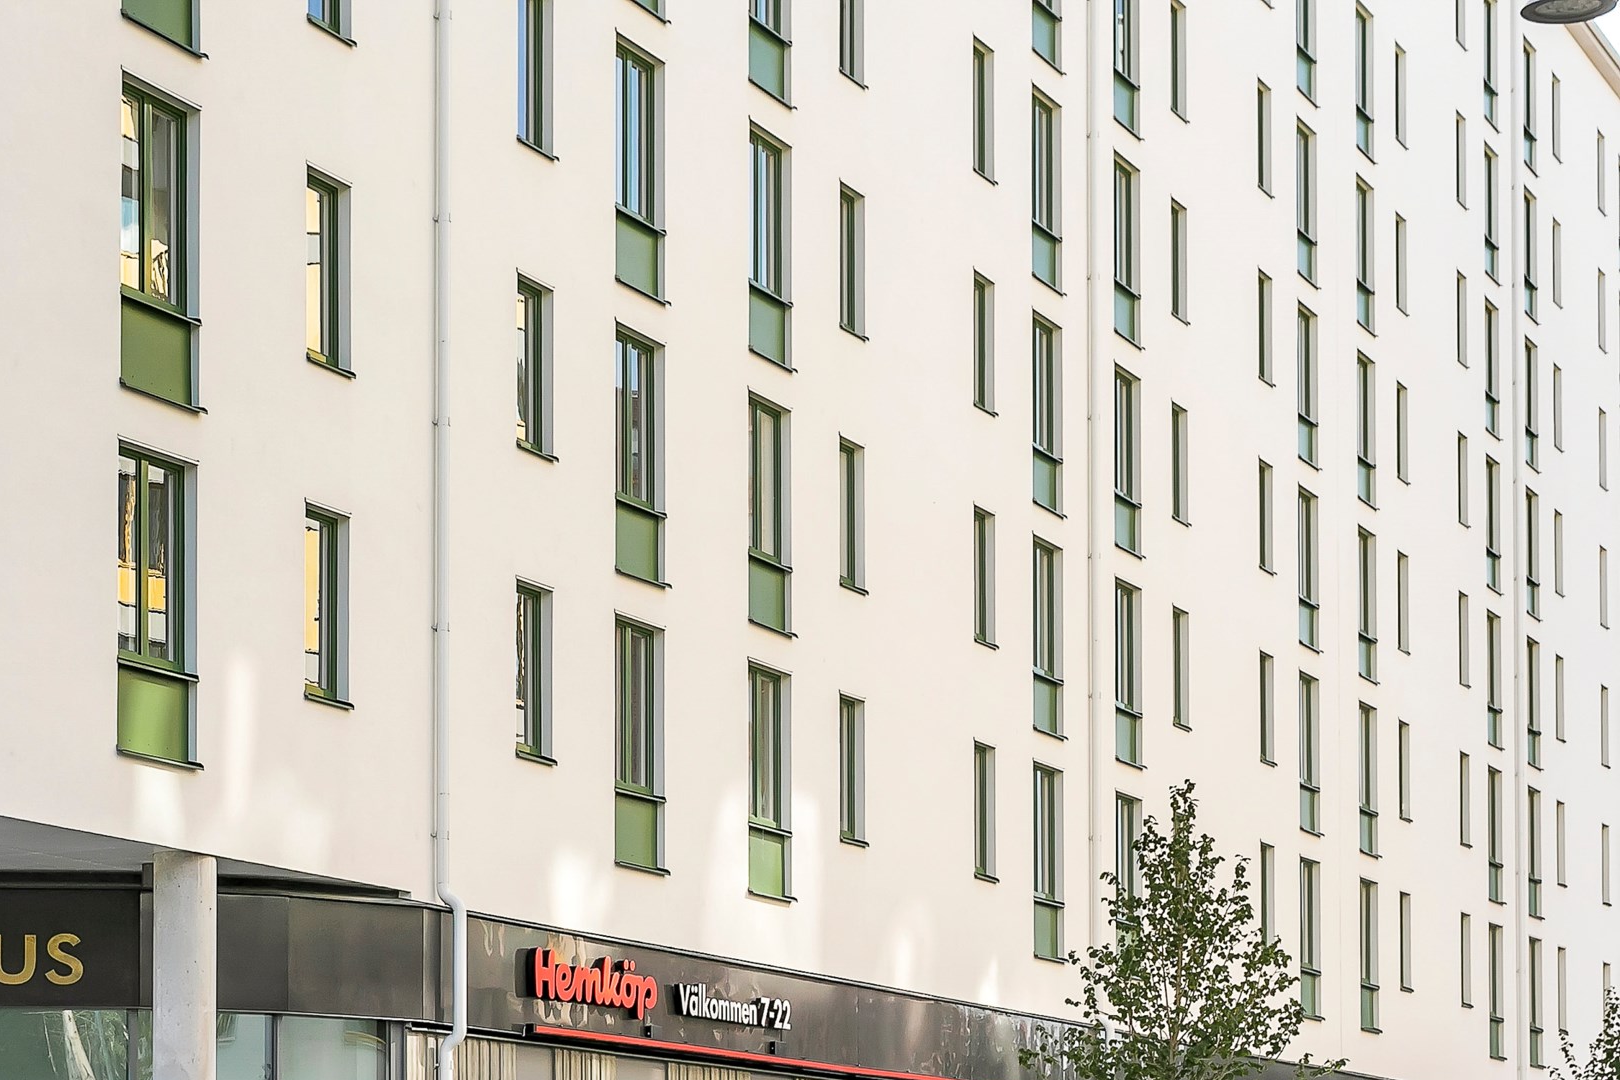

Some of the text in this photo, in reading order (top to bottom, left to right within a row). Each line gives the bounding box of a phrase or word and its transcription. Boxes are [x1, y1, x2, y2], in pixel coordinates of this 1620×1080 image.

[534, 947, 658, 1020] Hemköp
[679, 983, 791, 1030] Välkommen 7-22
